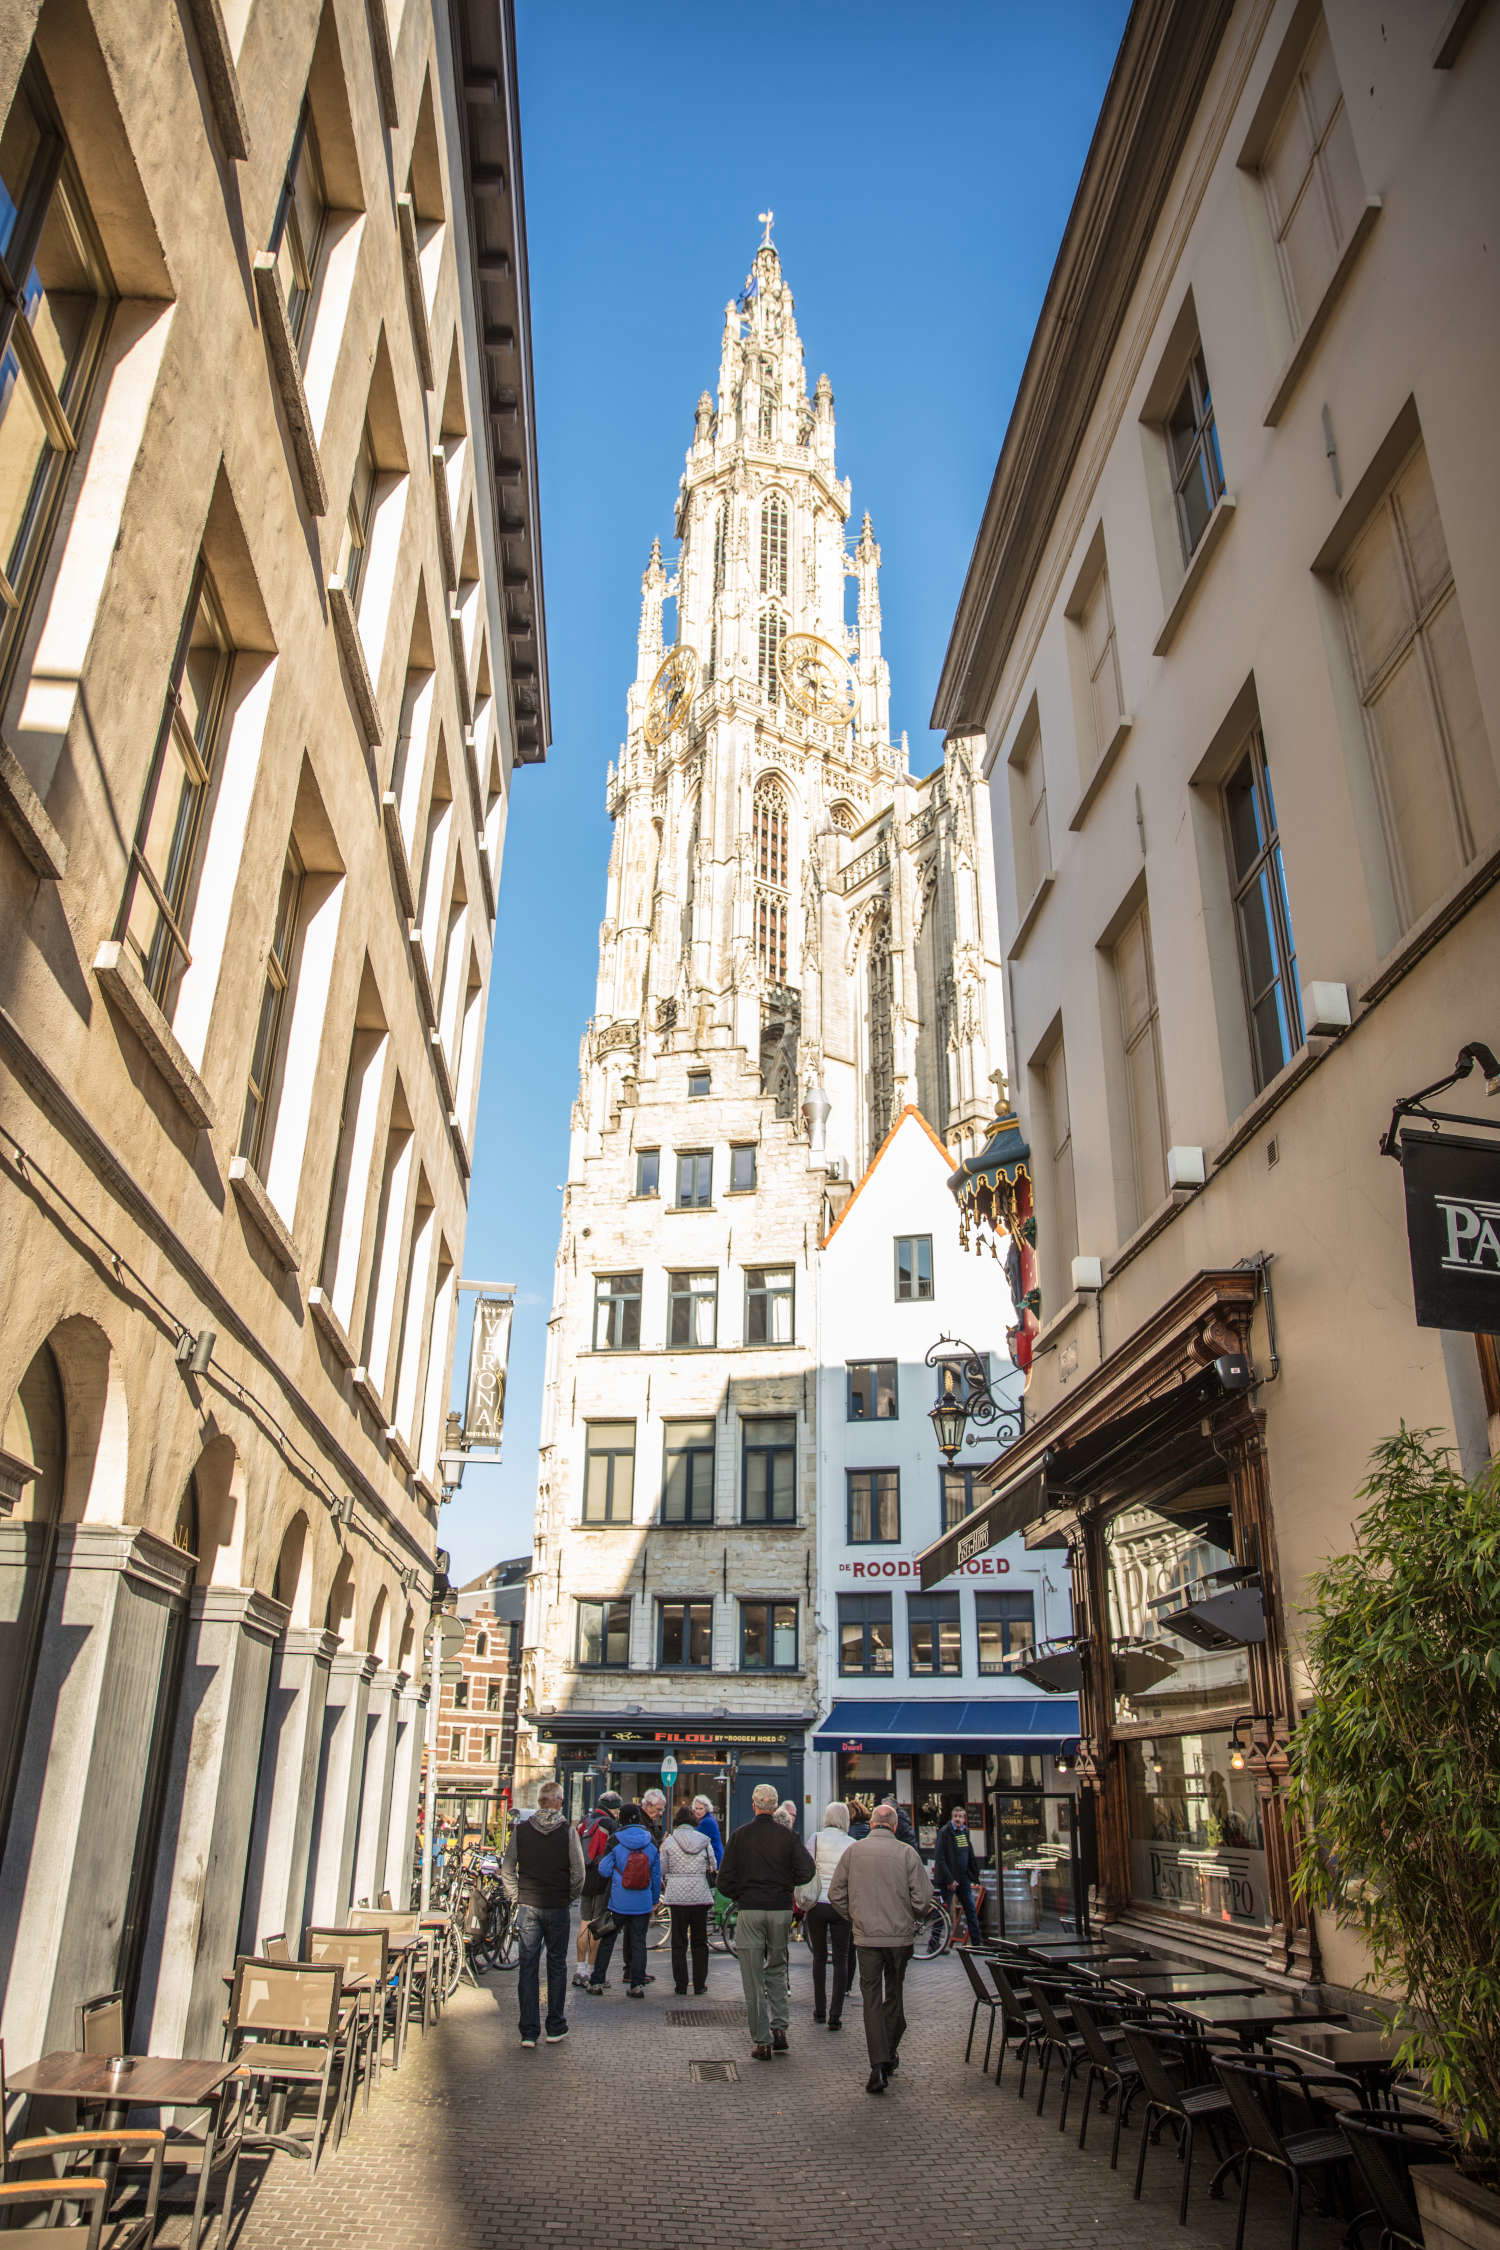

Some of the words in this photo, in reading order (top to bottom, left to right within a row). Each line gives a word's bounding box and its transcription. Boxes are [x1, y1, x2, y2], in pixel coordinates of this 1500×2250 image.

[475, 1319, 500, 1426] VERONA
[853, 1561, 922, 1577] ROODE
[655, 1732, 713, 1743] FILOU
